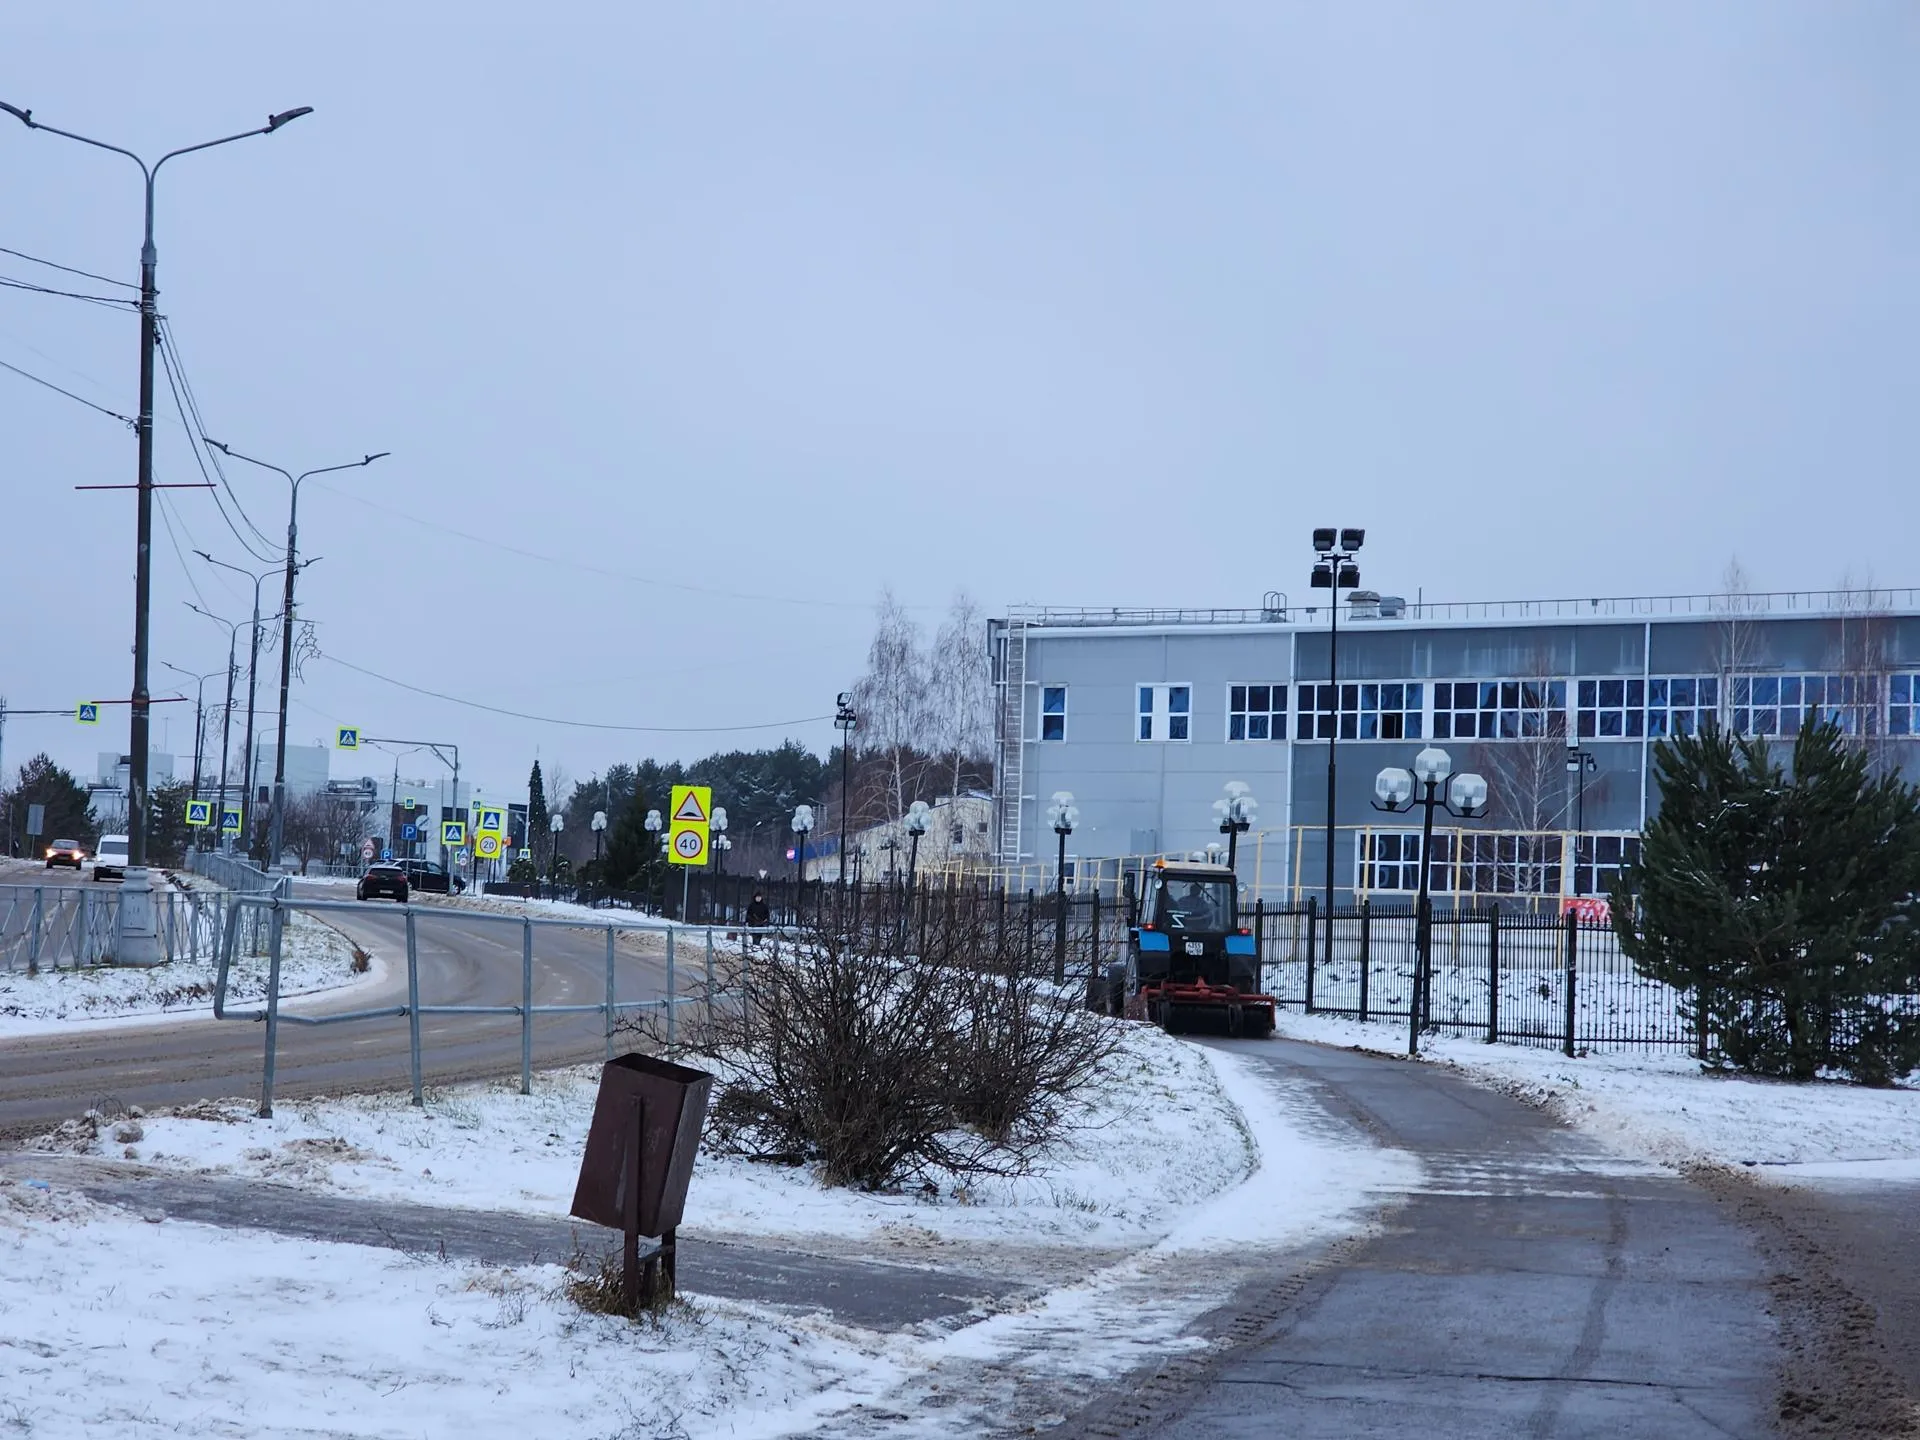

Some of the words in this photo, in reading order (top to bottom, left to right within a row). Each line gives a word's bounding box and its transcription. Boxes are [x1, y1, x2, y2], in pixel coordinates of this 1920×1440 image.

[406, 827, 414, 837] P
[484, 841, 494, 849] 20
[680, 839, 697, 850] 40
